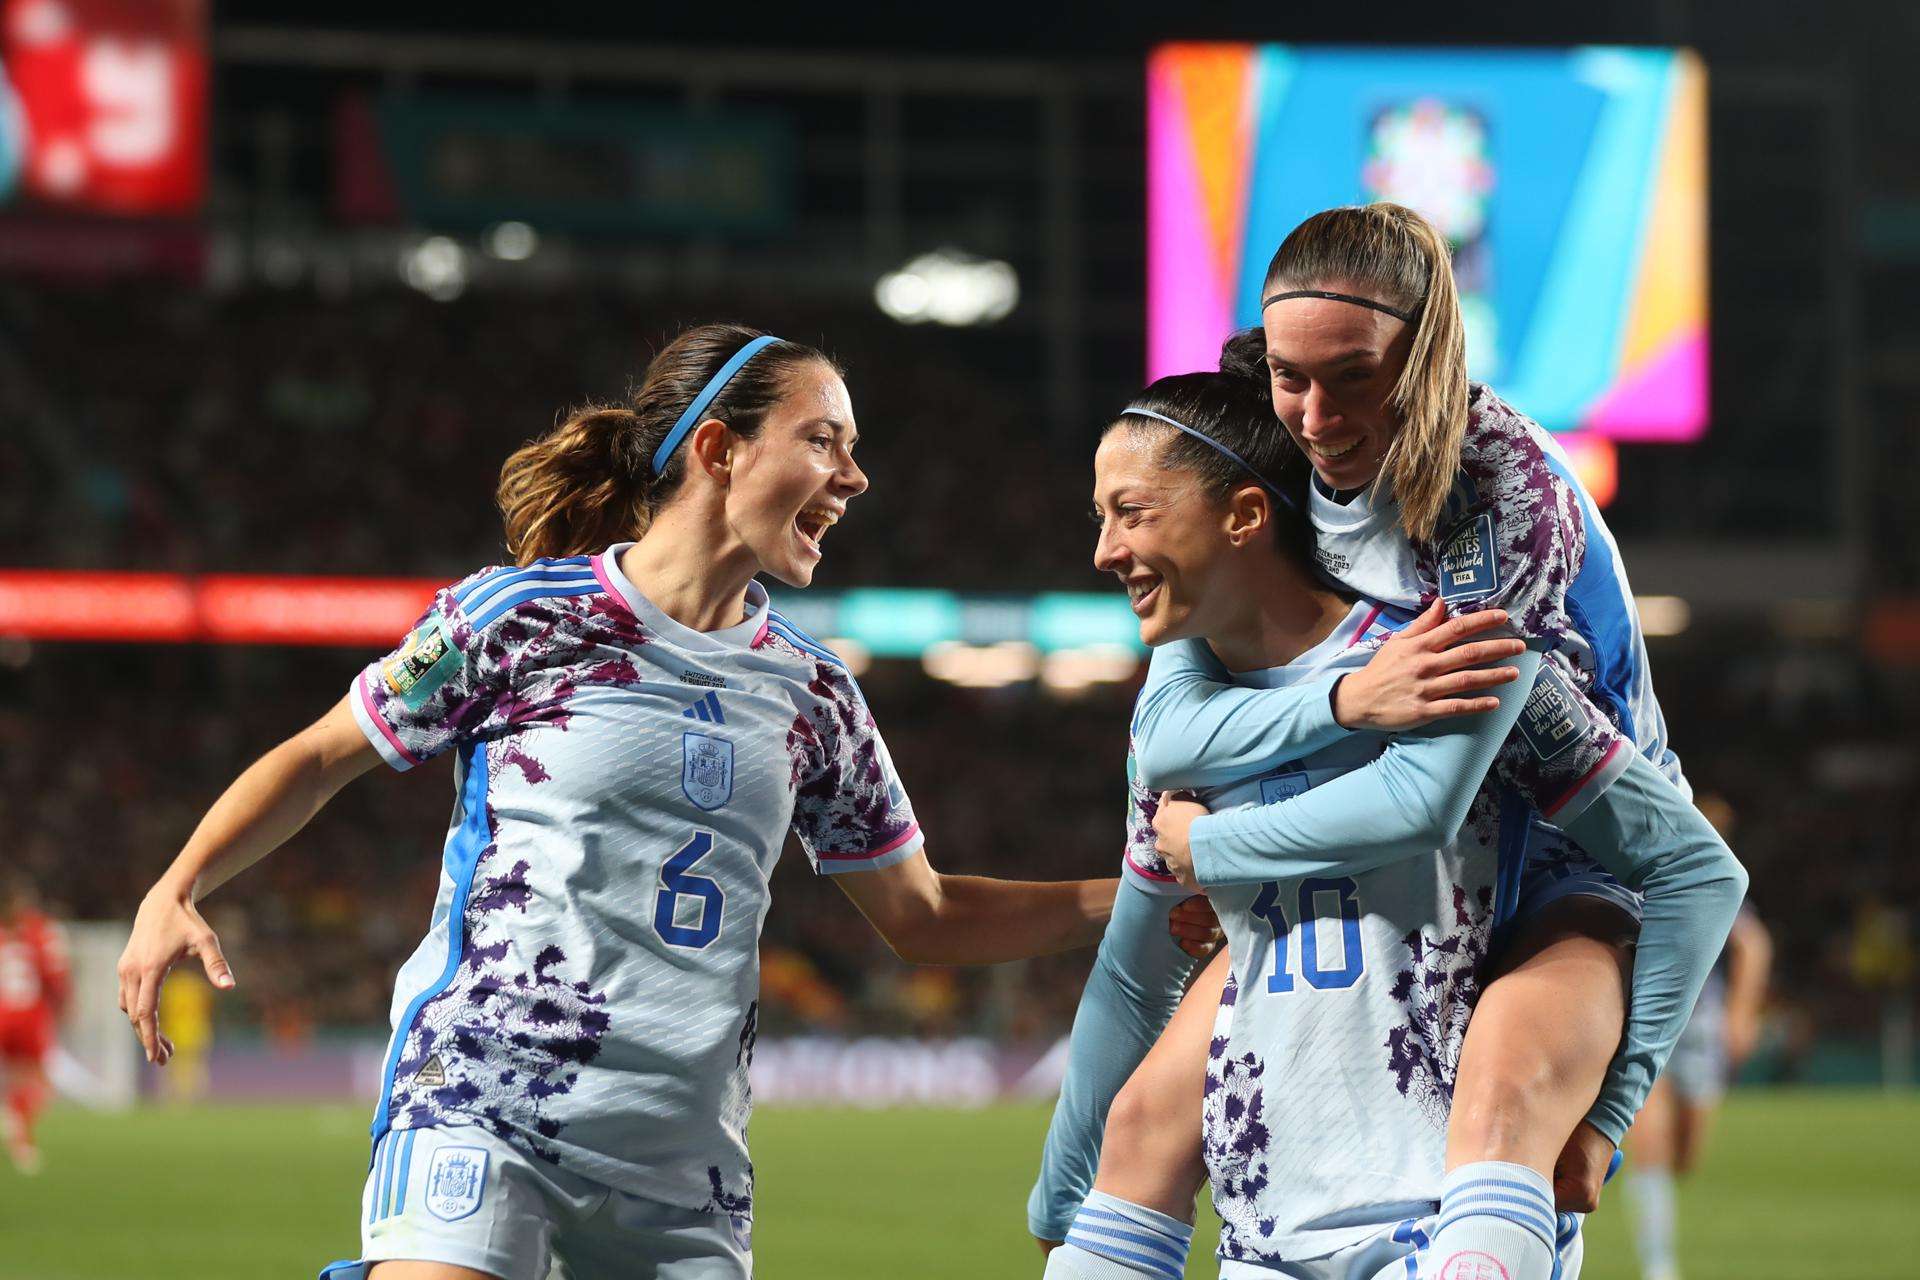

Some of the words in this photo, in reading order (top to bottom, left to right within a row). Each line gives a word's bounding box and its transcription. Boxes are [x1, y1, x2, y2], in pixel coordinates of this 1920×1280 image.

[1333, 560, 1350, 570] 2023
[1455, 552, 1483, 569] World
[1455, 573, 1471, 582] FIFA
[1525, 687, 1563, 722] UNITES
[1548, 698, 1573, 725] World
[1554, 722, 1572, 737] FIFA
[653, 829, 726, 951] 6
[1249, 875, 1367, 999] 10
